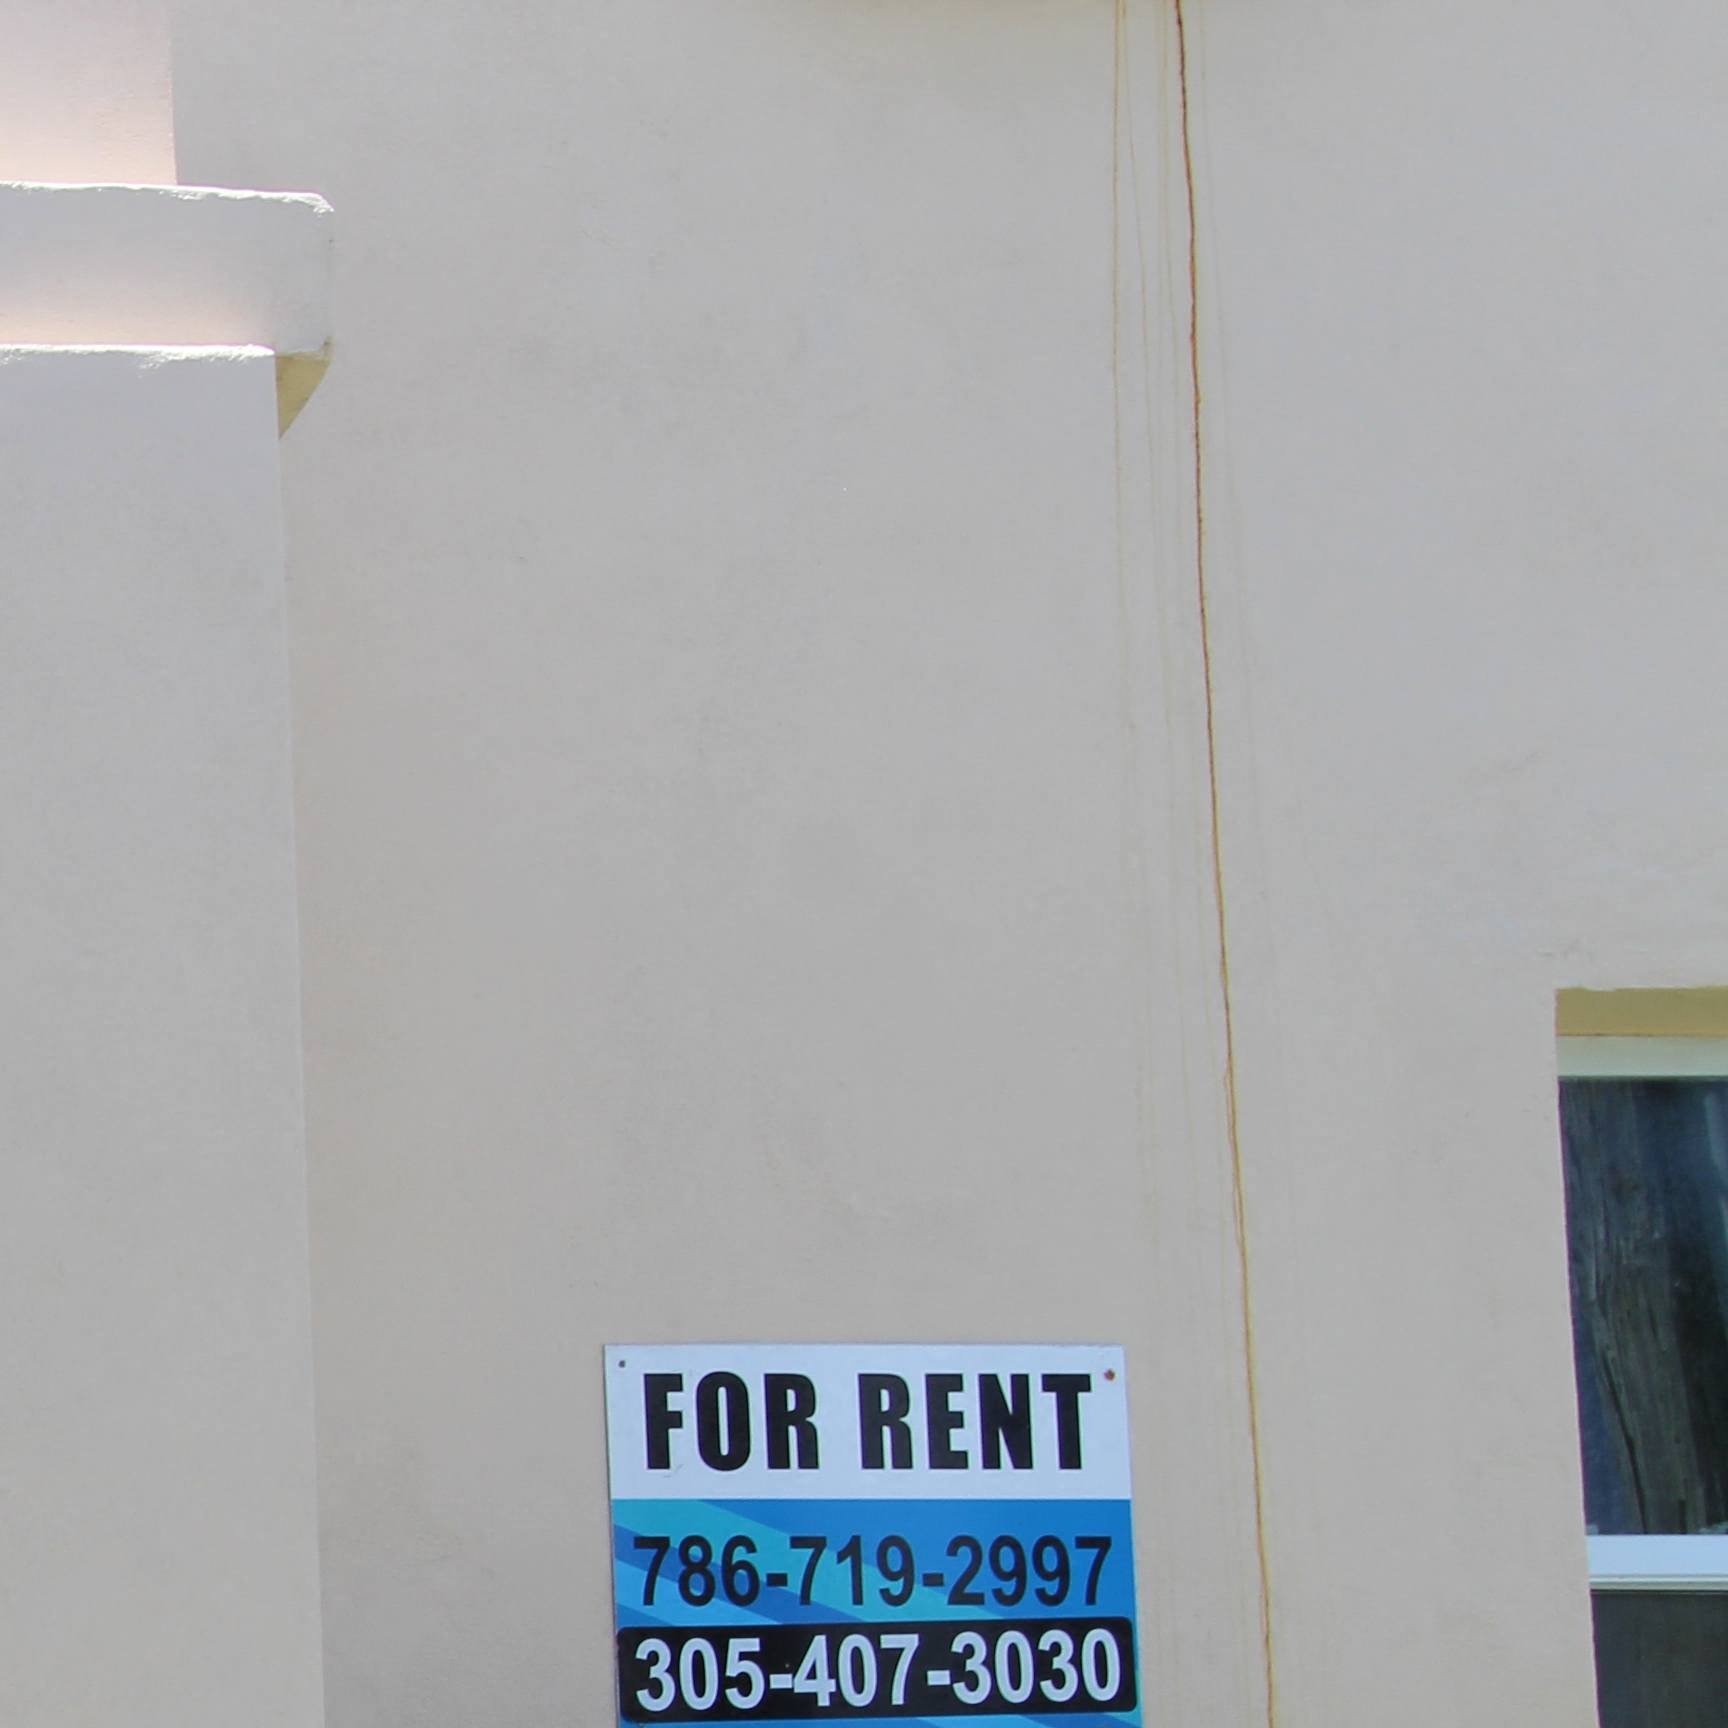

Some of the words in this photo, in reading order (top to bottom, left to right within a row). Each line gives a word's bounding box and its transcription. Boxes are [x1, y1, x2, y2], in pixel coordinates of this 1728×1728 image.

[643, 1371, 820, 1472] FOR
[857, 1372, 1093, 1471] RENT
[633, 1535, 1113, 1607] 786-719-2997
[635, 1628, 1121, 1712] 305-407-3030
